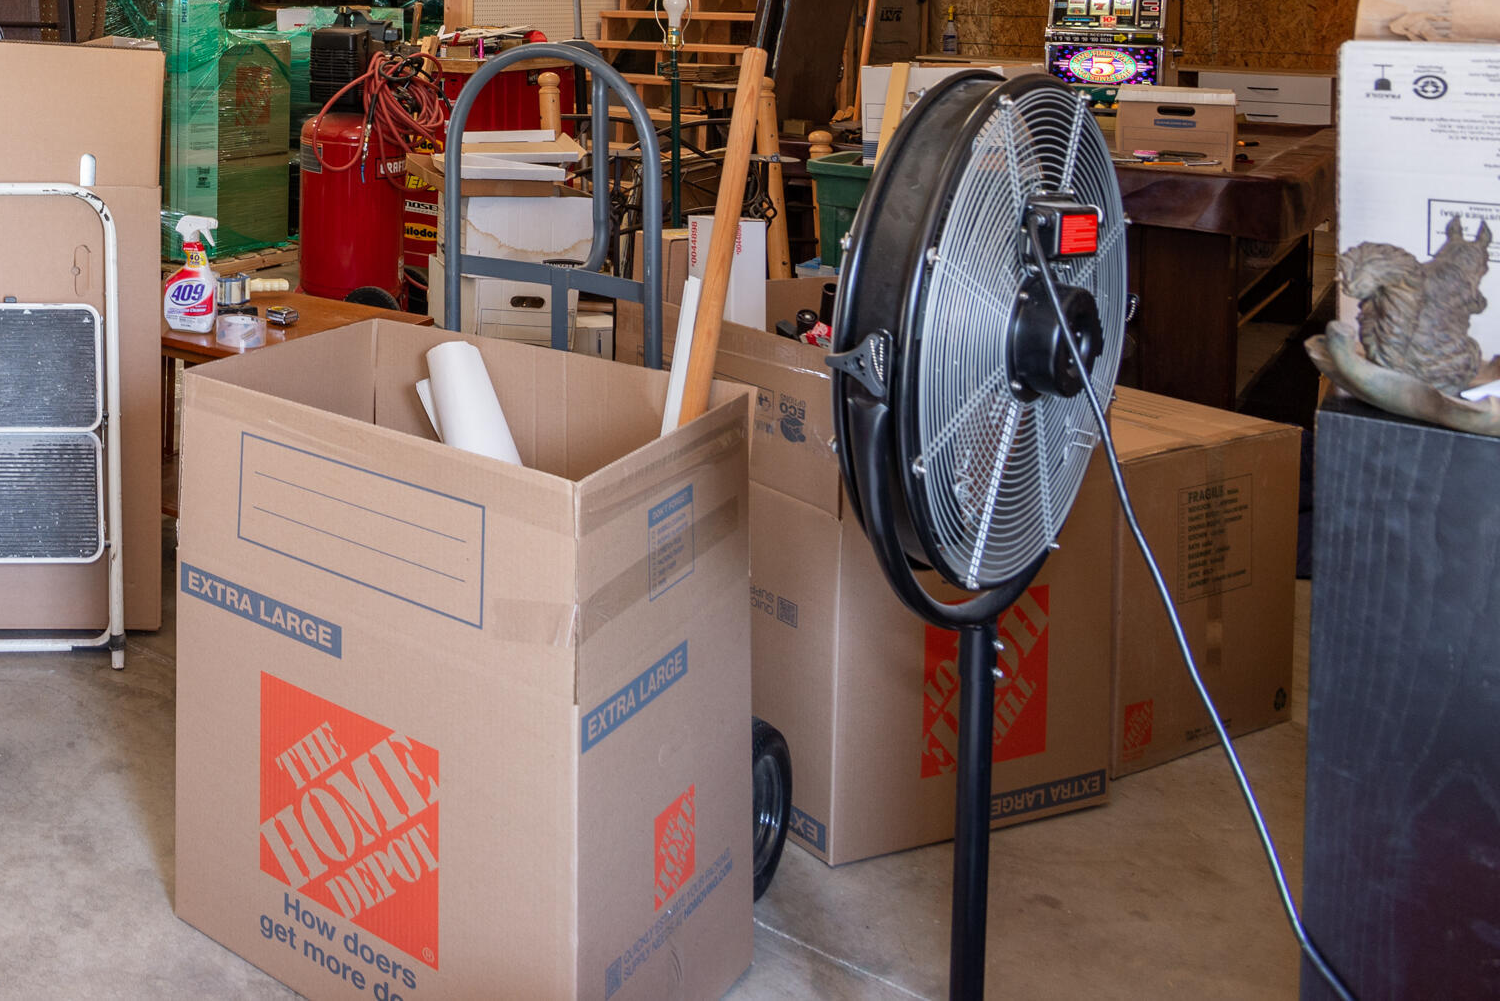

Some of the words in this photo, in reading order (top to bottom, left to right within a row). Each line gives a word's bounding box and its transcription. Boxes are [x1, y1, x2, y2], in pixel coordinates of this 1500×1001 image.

[1089, 56, 1116, 77] 5
[171, 283, 206, 302] 409
[780, 402, 805, 420] ECO
[1188, 485, 1225, 504] FRAGILE
[188, 570, 253, 615] EXTRA
[260, 600, 333, 648] LARGE
[588, 688, 636, 742] EXTRA
[640, 650, 683, 702] LARGE
[275, 720, 348, 790] THE
[1050, 774, 1101, 797] EXTRA
[260, 732, 439, 890] HOME
[991, 789, 1045, 814] LARGE
[325, 823, 439, 919] DEPOT
[260, 914, 297, 950] get
[303, 939, 366, 991] more
[283, 893, 336, 942] How
[343, 932, 417, 990] doers
